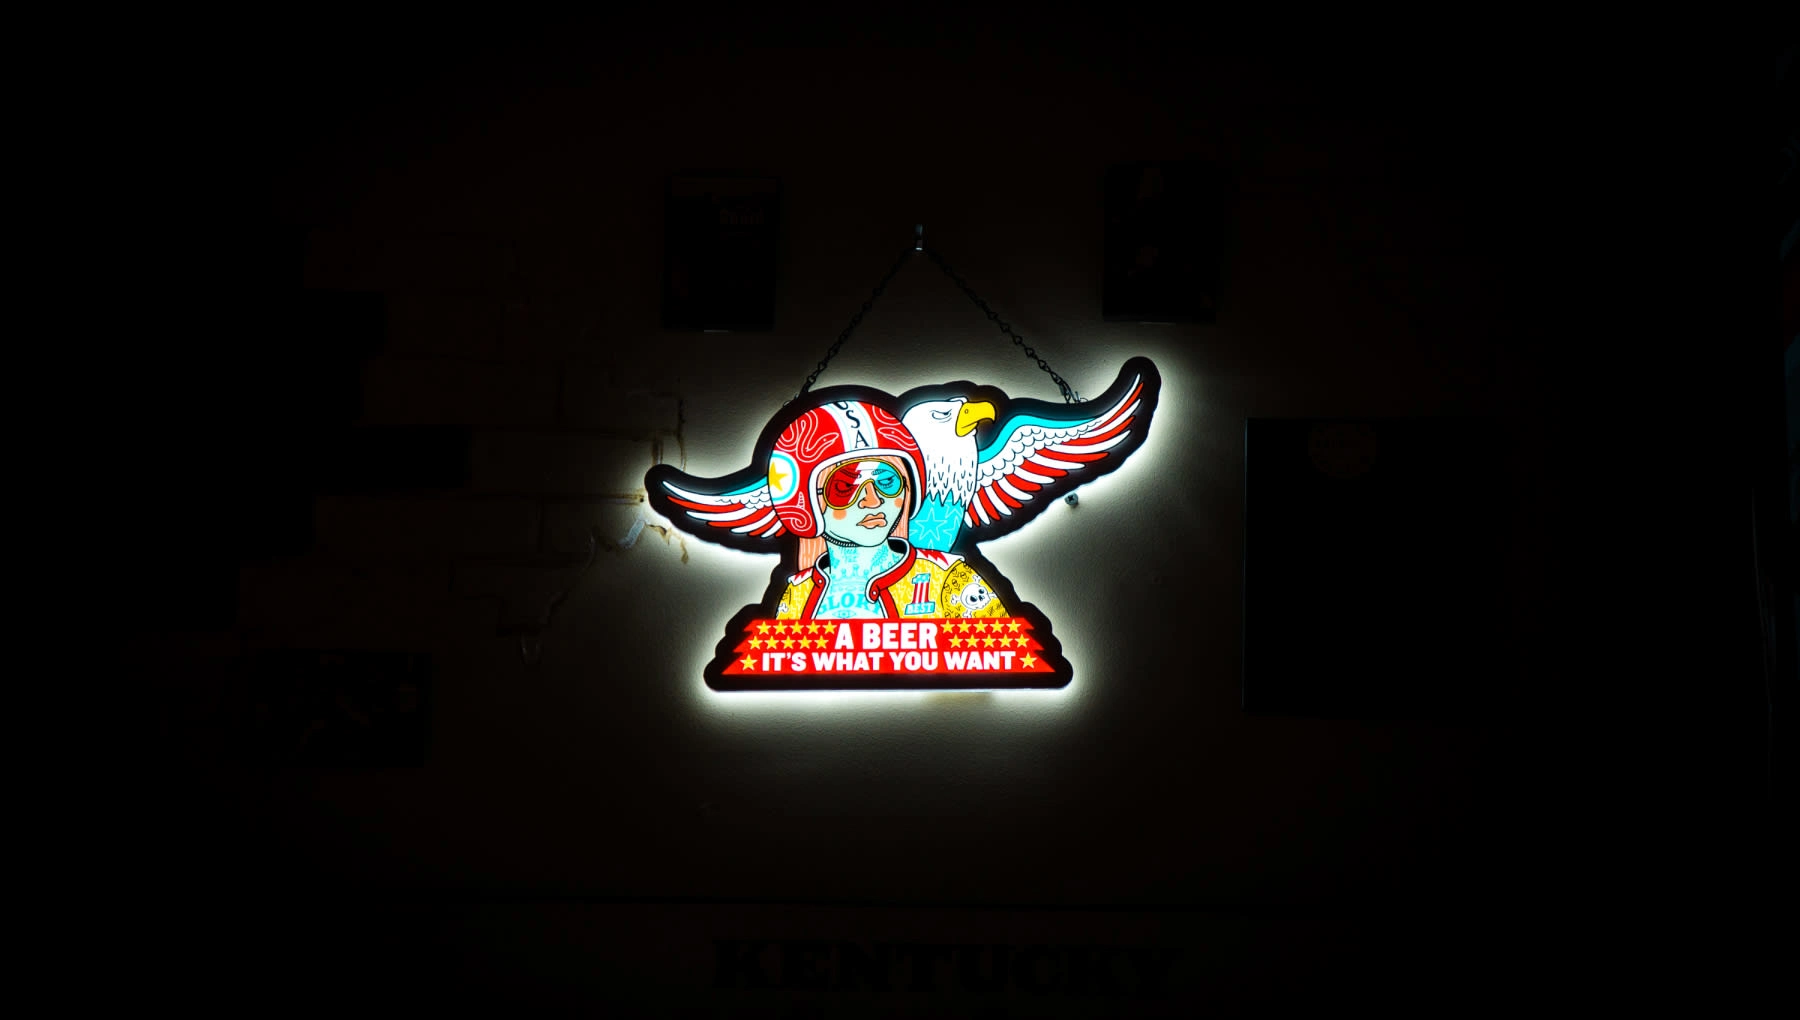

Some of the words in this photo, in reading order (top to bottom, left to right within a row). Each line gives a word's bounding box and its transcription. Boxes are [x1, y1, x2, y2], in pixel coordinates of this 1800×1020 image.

[907, 602, 933, 614] BEST
[834, 622, 855, 650] A
[862, 622, 938, 650] BEER
[762, 651, 807, 672] IT'S
[811, 651, 884, 671] WHAT
[888, 651, 939, 671] YOU
[943, 650, 1016, 670] WANT
[712, 939, 1184, 1000] KENTUCKY
